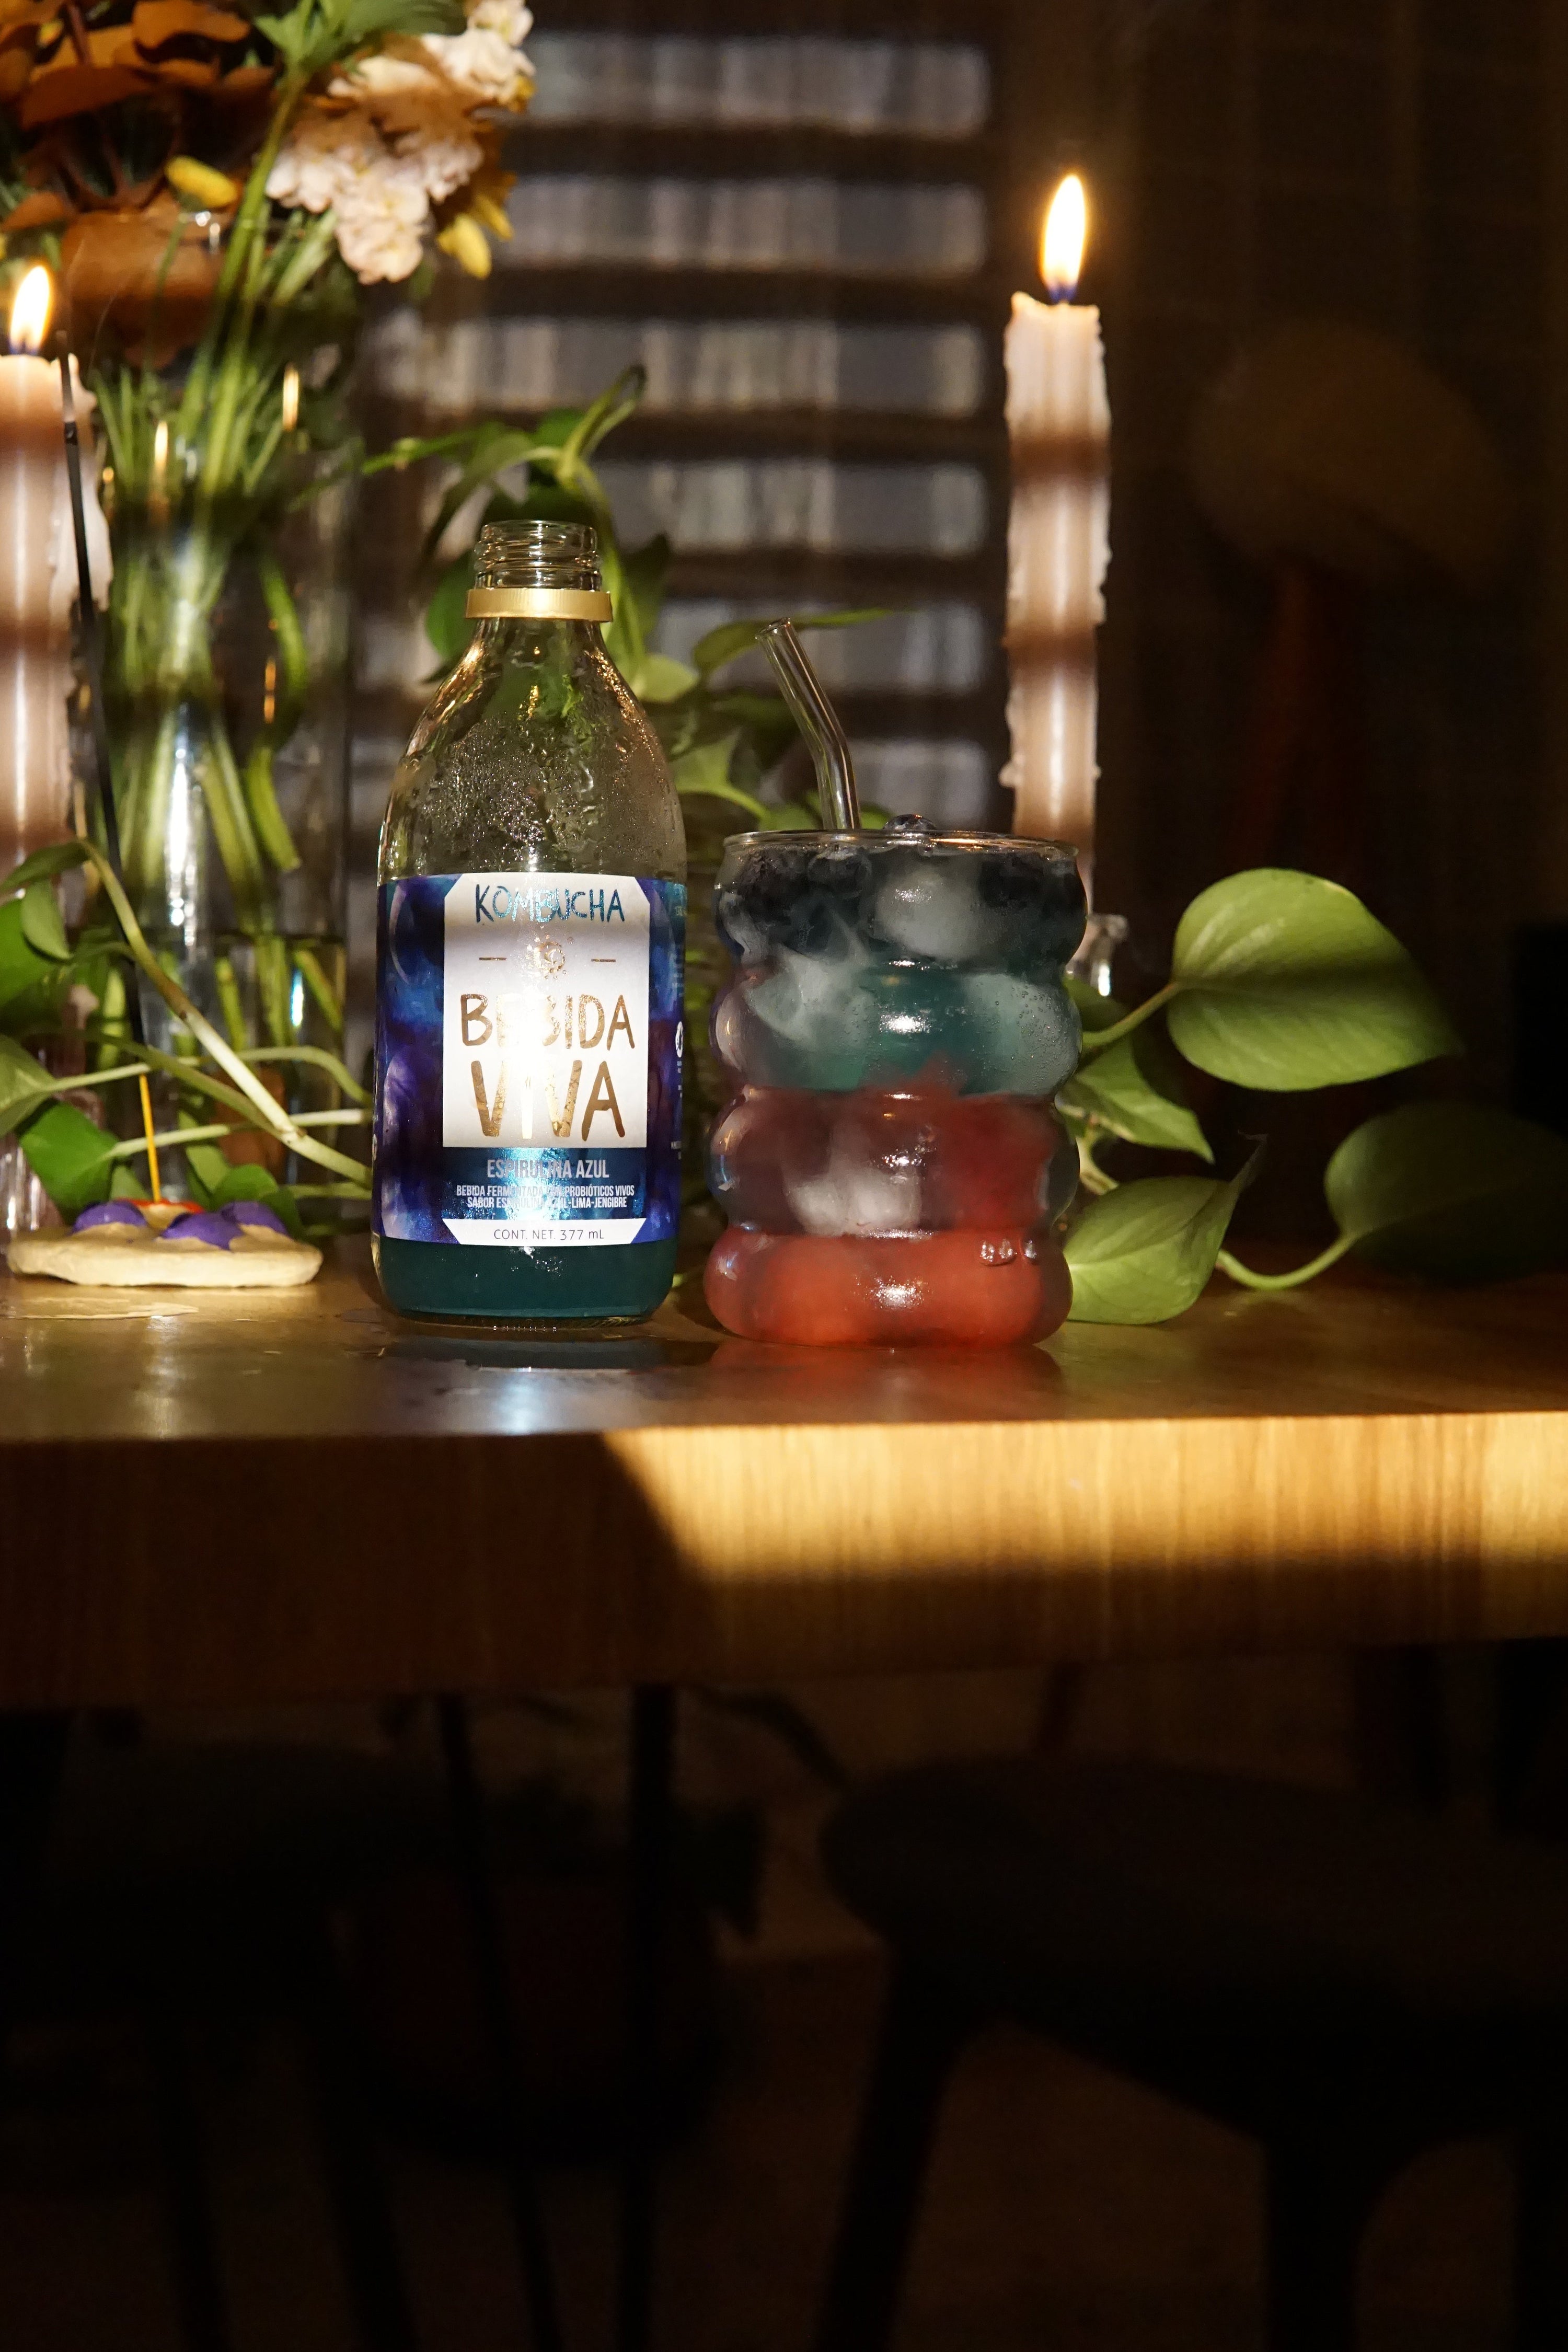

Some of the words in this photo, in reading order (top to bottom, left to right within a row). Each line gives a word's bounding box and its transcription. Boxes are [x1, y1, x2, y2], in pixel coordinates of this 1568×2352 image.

[476, 884, 625, 923] KOMBUCHA
[471, 1059, 626, 1142] VIVA
[487, 1159, 572, 1178] ESPIRULINA
[576, 1159, 610, 1178] AZUL
[457, 1185, 486, 1196] BEBIDA
[565, 1183, 614, 1196] PROBIÓTICOS
[615, 1185, 634, 1196] VIVOS
[467, 1197, 494, 1208] SABOR
[494, 1229, 527, 1240] CONT.
[532, 1229, 556, 1240] NET.
[560, 1229, 583, 1240] 377
[589, 1229, 604, 1239] mL
